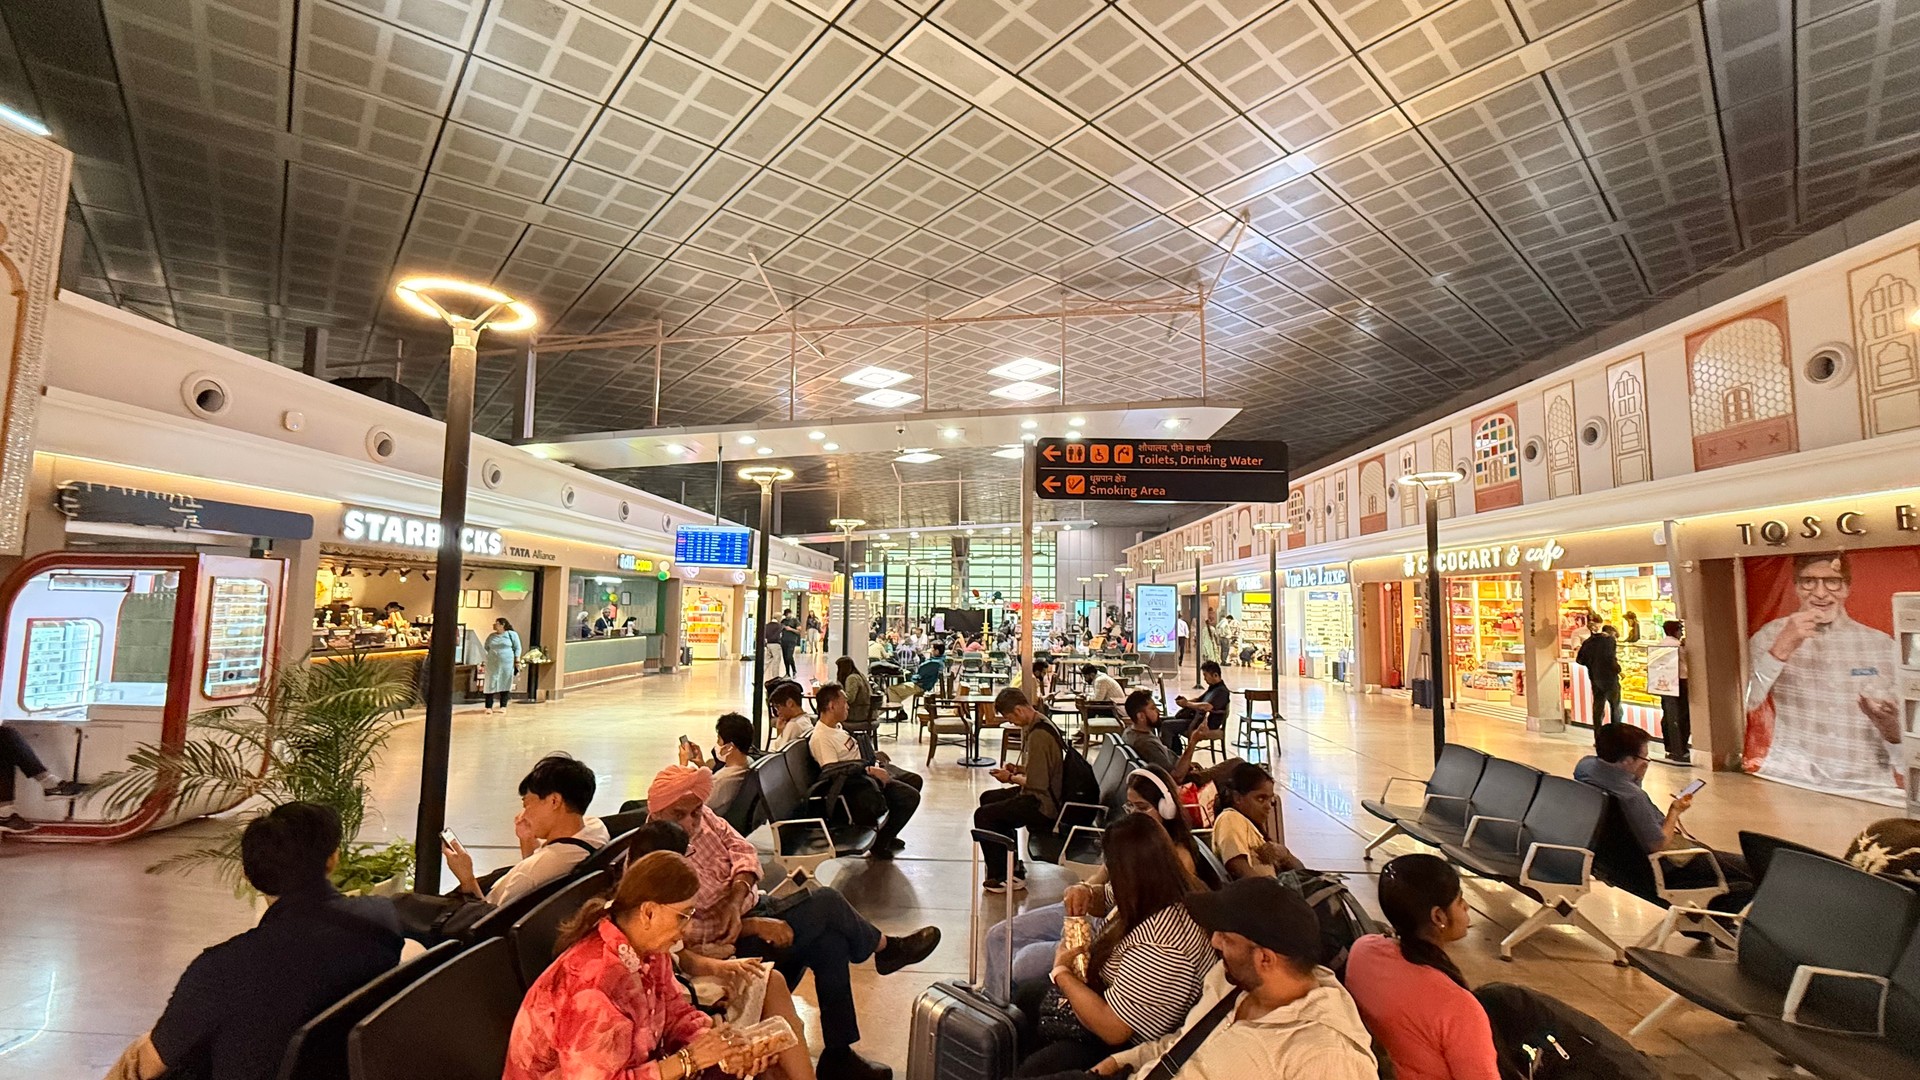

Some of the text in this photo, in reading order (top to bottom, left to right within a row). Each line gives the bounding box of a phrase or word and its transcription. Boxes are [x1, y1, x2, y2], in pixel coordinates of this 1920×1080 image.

[1196, 443, 1211, 453] पानी
[1138, 454, 1264, 467] Toilets, Drinking Water
[1089, 485, 1166, 497] Smoking Area
[343, 509, 502, 556] STARBCKS
[510, 547, 531, 558] TATA
[532, 551, 556, 561] Alliance
[1417, 547, 1503, 574] CCOCART
[1284, 569, 1302, 588] Vue
[1302, 566, 1317, 586] De
[1318, 565, 1346, 585] Luxe
